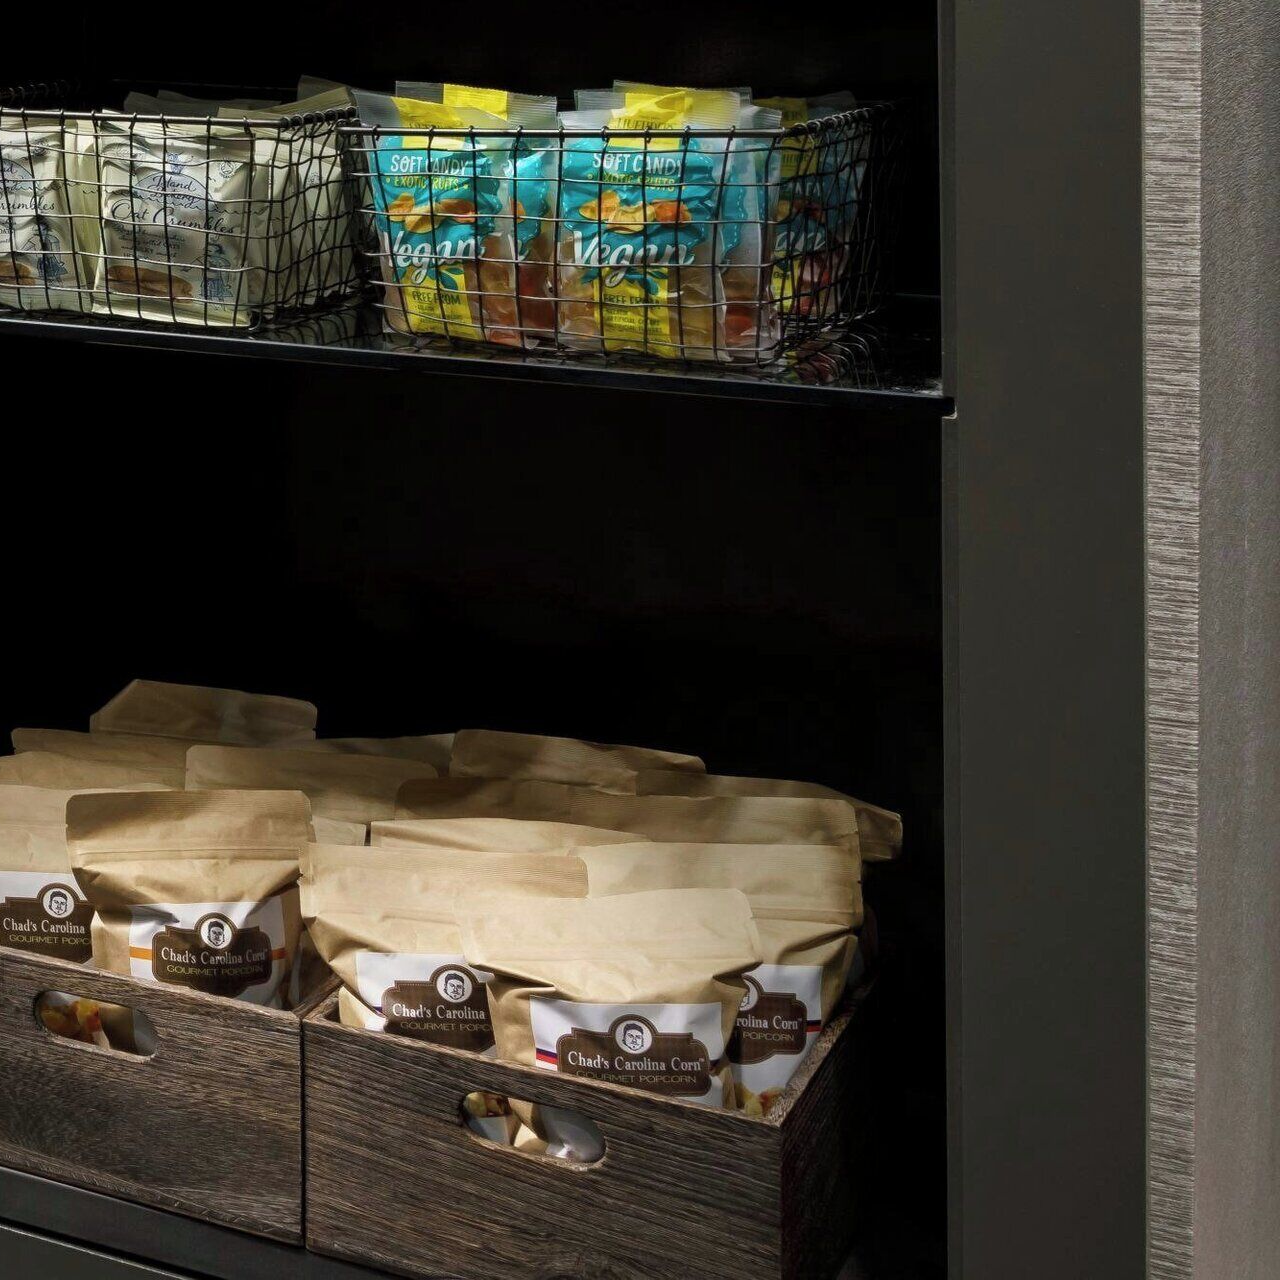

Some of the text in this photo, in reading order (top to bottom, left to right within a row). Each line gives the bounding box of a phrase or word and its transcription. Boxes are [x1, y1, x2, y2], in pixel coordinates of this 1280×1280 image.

[390, 154, 427, 174] SOFT
[592, 151, 630, 170] SOFT
[394, 176, 426, 190] EXOTIC
[383, 231, 486, 285] Vegan
[573, 230, 695, 289] Vegan
[2, 918, 85, 934] Chad's Carolina
[9, 934, 91, 946] GOURMET POPC
[161, 947, 196, 965] Chad's
[200, 949, 243, 966] Carolina
[166, 964, 218, 976] GOURMET
[392, 1003, 486, 1020] Chad's Carolina
[400, 1021, 491, 1033] GOURMET POPC
[736, 1015, 769, 1029] rolina
[742, 1031, 796, 1042] POPCORN
[568, 1051, 610, 1070] Chad's
[614, 1055, 667, 1072] Carolina
[638, 1073, 697, 1085] POPCORN
